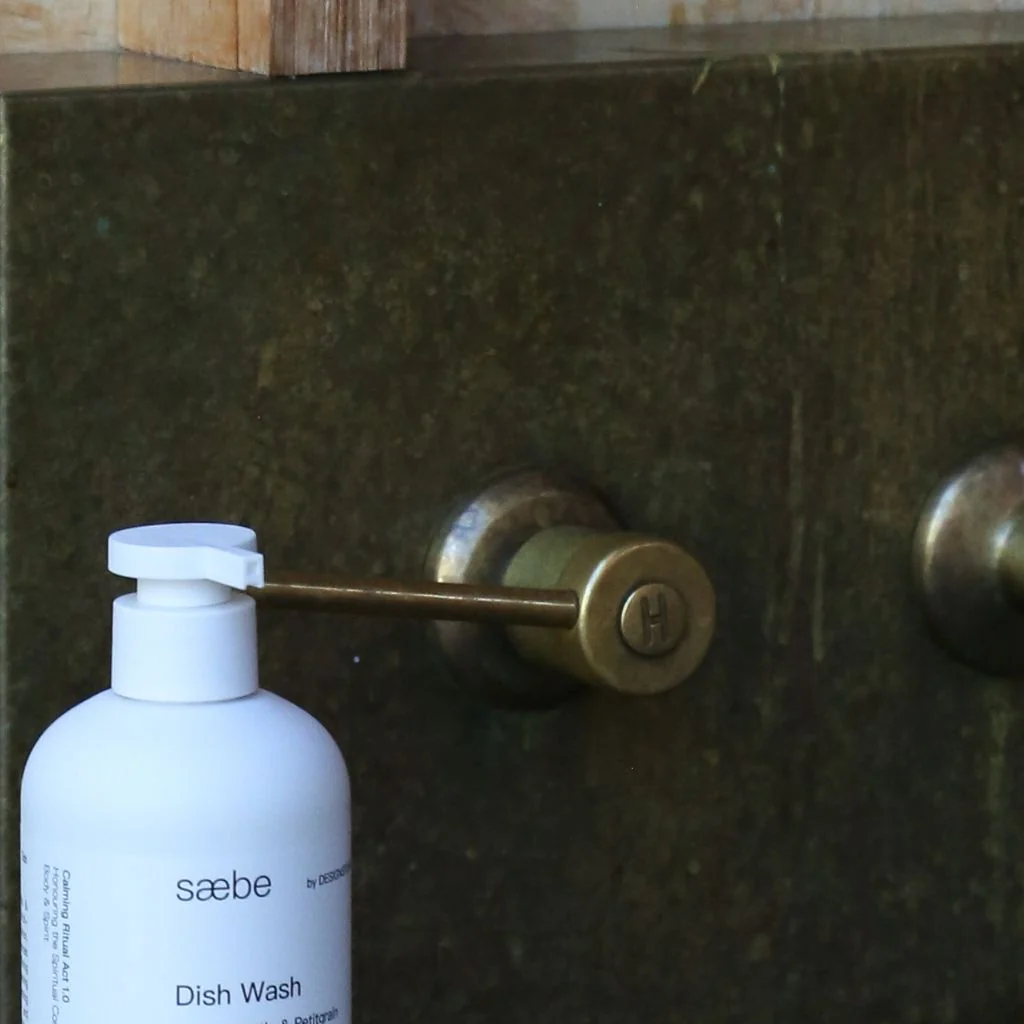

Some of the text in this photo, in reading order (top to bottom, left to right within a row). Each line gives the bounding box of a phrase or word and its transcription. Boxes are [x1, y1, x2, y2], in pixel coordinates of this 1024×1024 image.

[639, 591, 668, 647] H
[43, 863, 51, 894] Body
[51, 866, 59, 927] Honouring
[176, 869, 271, 902] sæbe
[306, 878, 317, 890] by
[61, 869, 71, 1004] Calming Ritual Act 1.0
[52, 953, 60, 1001] Spiritual
[175, 976, 301, 1006] Dish Wash
